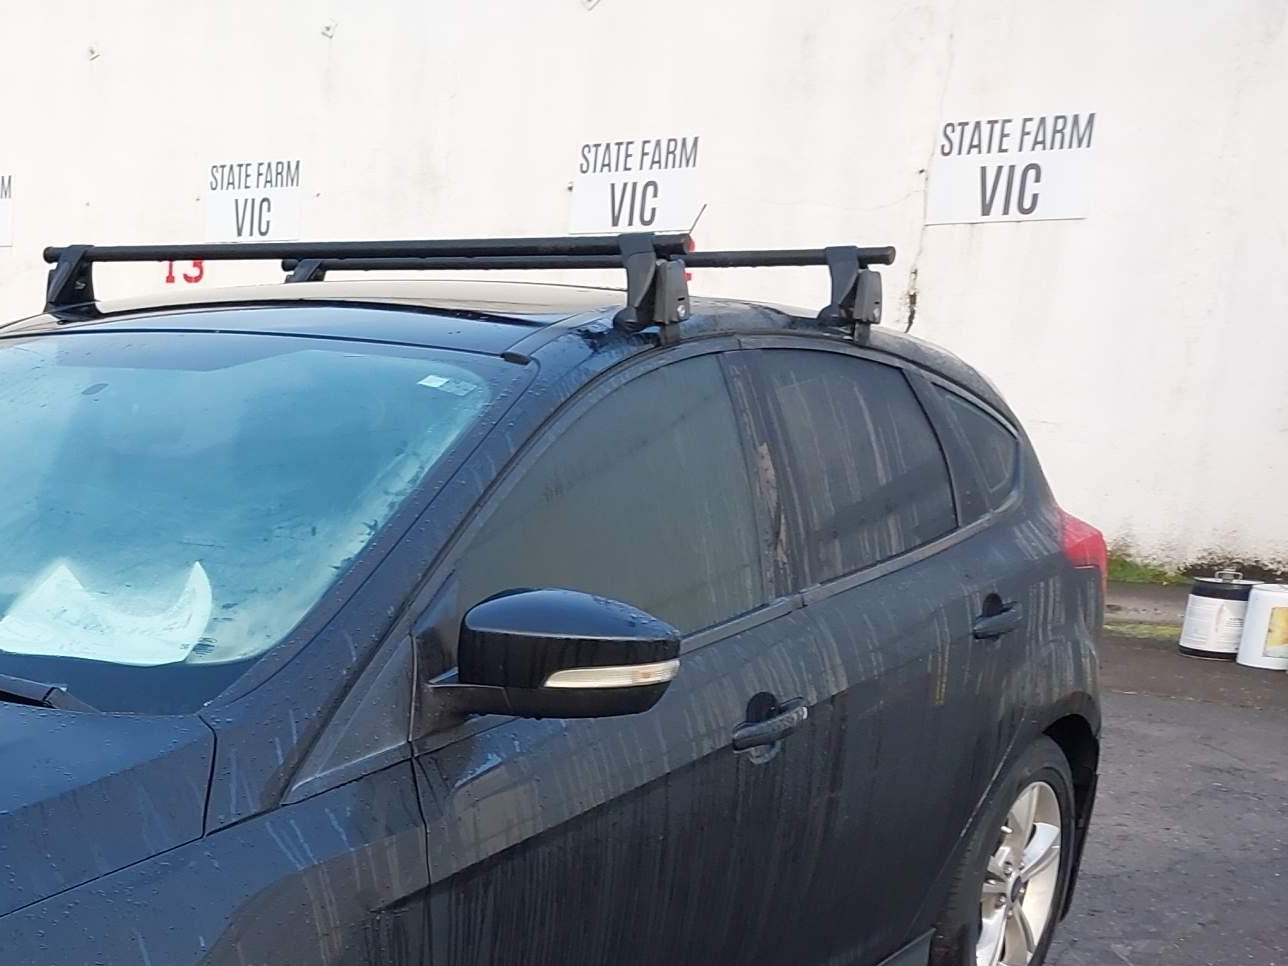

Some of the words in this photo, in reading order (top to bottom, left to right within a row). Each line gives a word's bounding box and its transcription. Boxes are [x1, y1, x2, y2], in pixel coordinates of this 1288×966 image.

[579, 140, 635, 175] STATE
[639, 136, 699, 171] FARM
[940, 118, 1013, 157] STATE
[1018, 112, 1097, 152] FARM
[210, 163, 252, 191] STATE
[256, 159, 300, 189] FARM
[979, 162, 1043, 217] VIC
[234, 197, 272, 237] VIC
[610, 180, 659, 228] VIC
